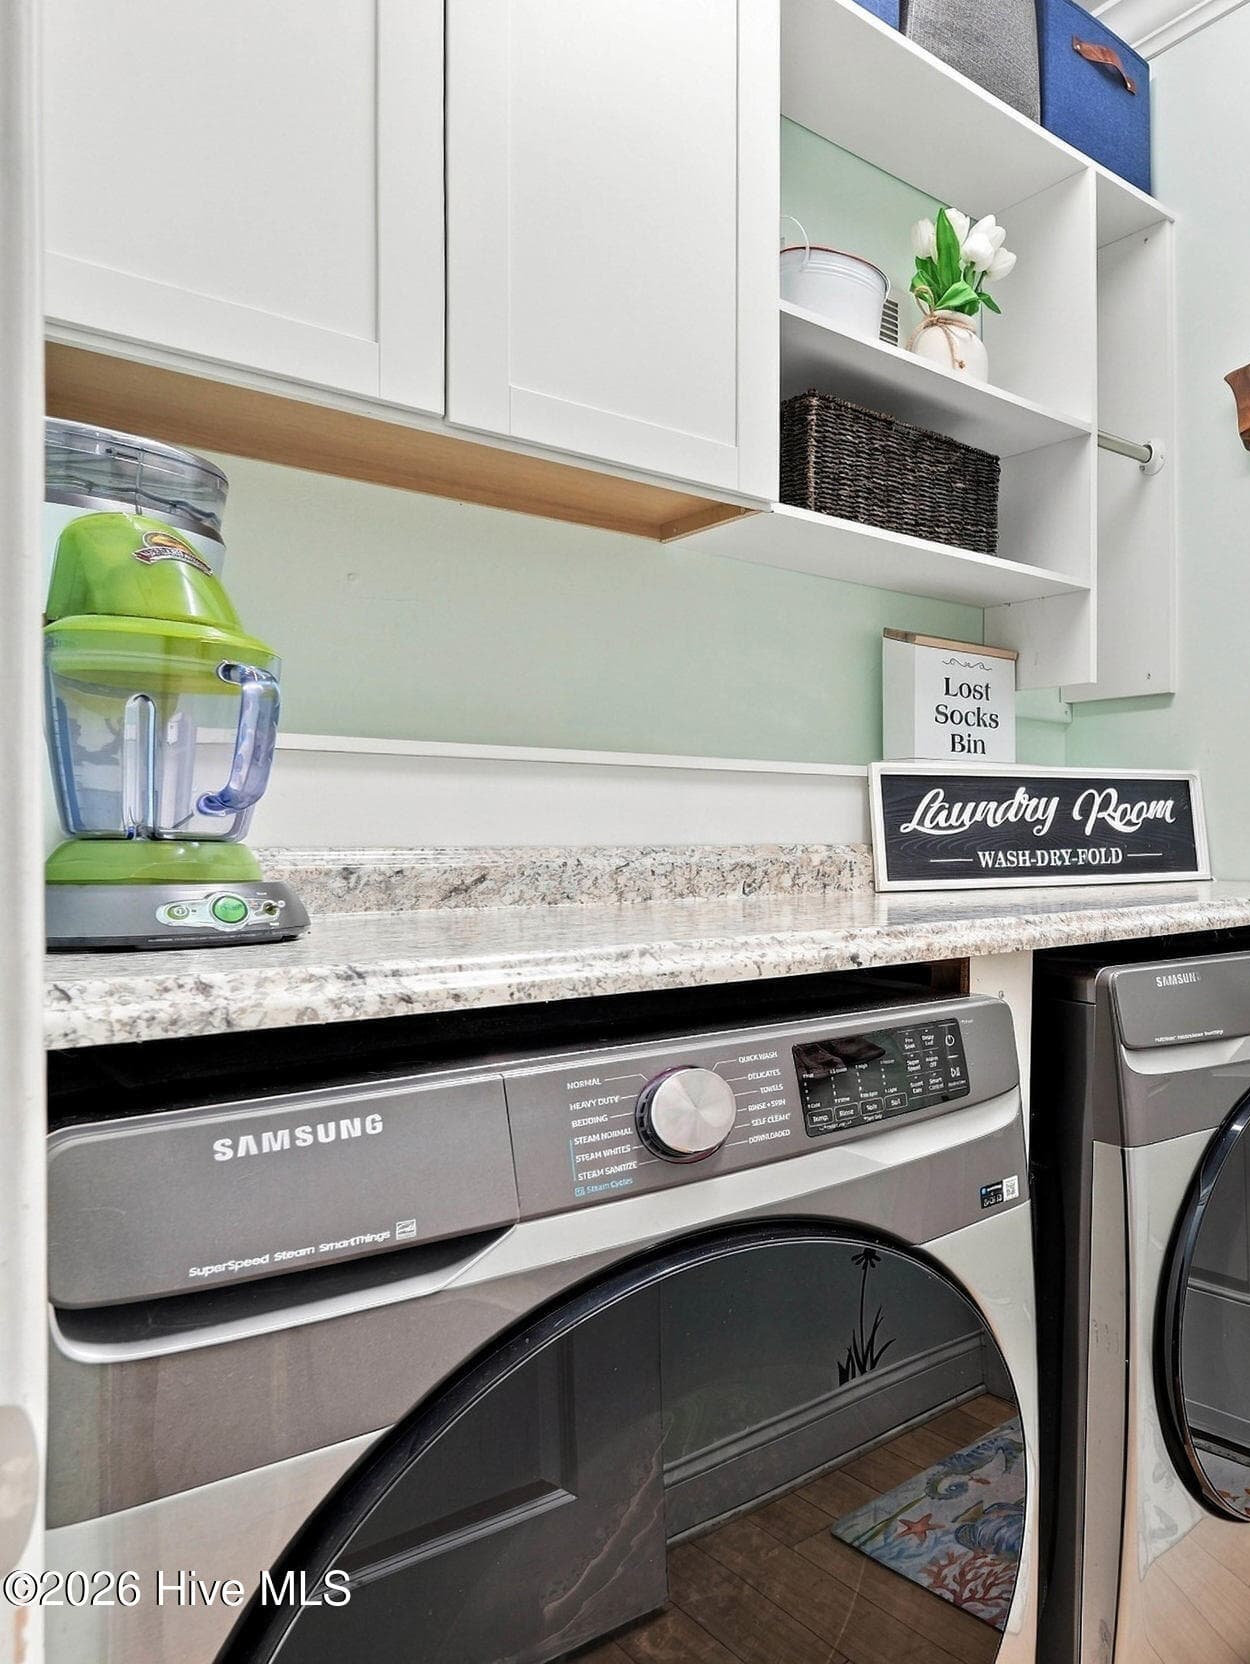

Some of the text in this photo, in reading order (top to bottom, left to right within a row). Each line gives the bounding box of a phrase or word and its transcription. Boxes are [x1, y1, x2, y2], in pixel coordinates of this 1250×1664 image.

[943, 677, 991, 700] Lost
[934, 704, 1000, 730] Socks
[950, 733, 986, 755] Bin
[900, 786, 1177, 836] Laundry Room
[977, 848, 1123, 869] WASH-DRY-FOLD
[566, 1078, 602, 1090] NORMAL
[569, 1095, 620, 1111] HEAVY DUTY
[571, 1114, 609, 1128] BEDDING
[212, 1113, 384, 1162] SAMSUNG
[573, 1127, 634, 1146] STEAM NORMAL
[575, 1144, 631, 1163] STEAM WHITES
[577, 1161, 638, 1181] STEAM SANITIZE
[586, 1183, 610, 1194] Steam
[188, 1230, 391, 1277] SuperSpeed Steam SmartThings
